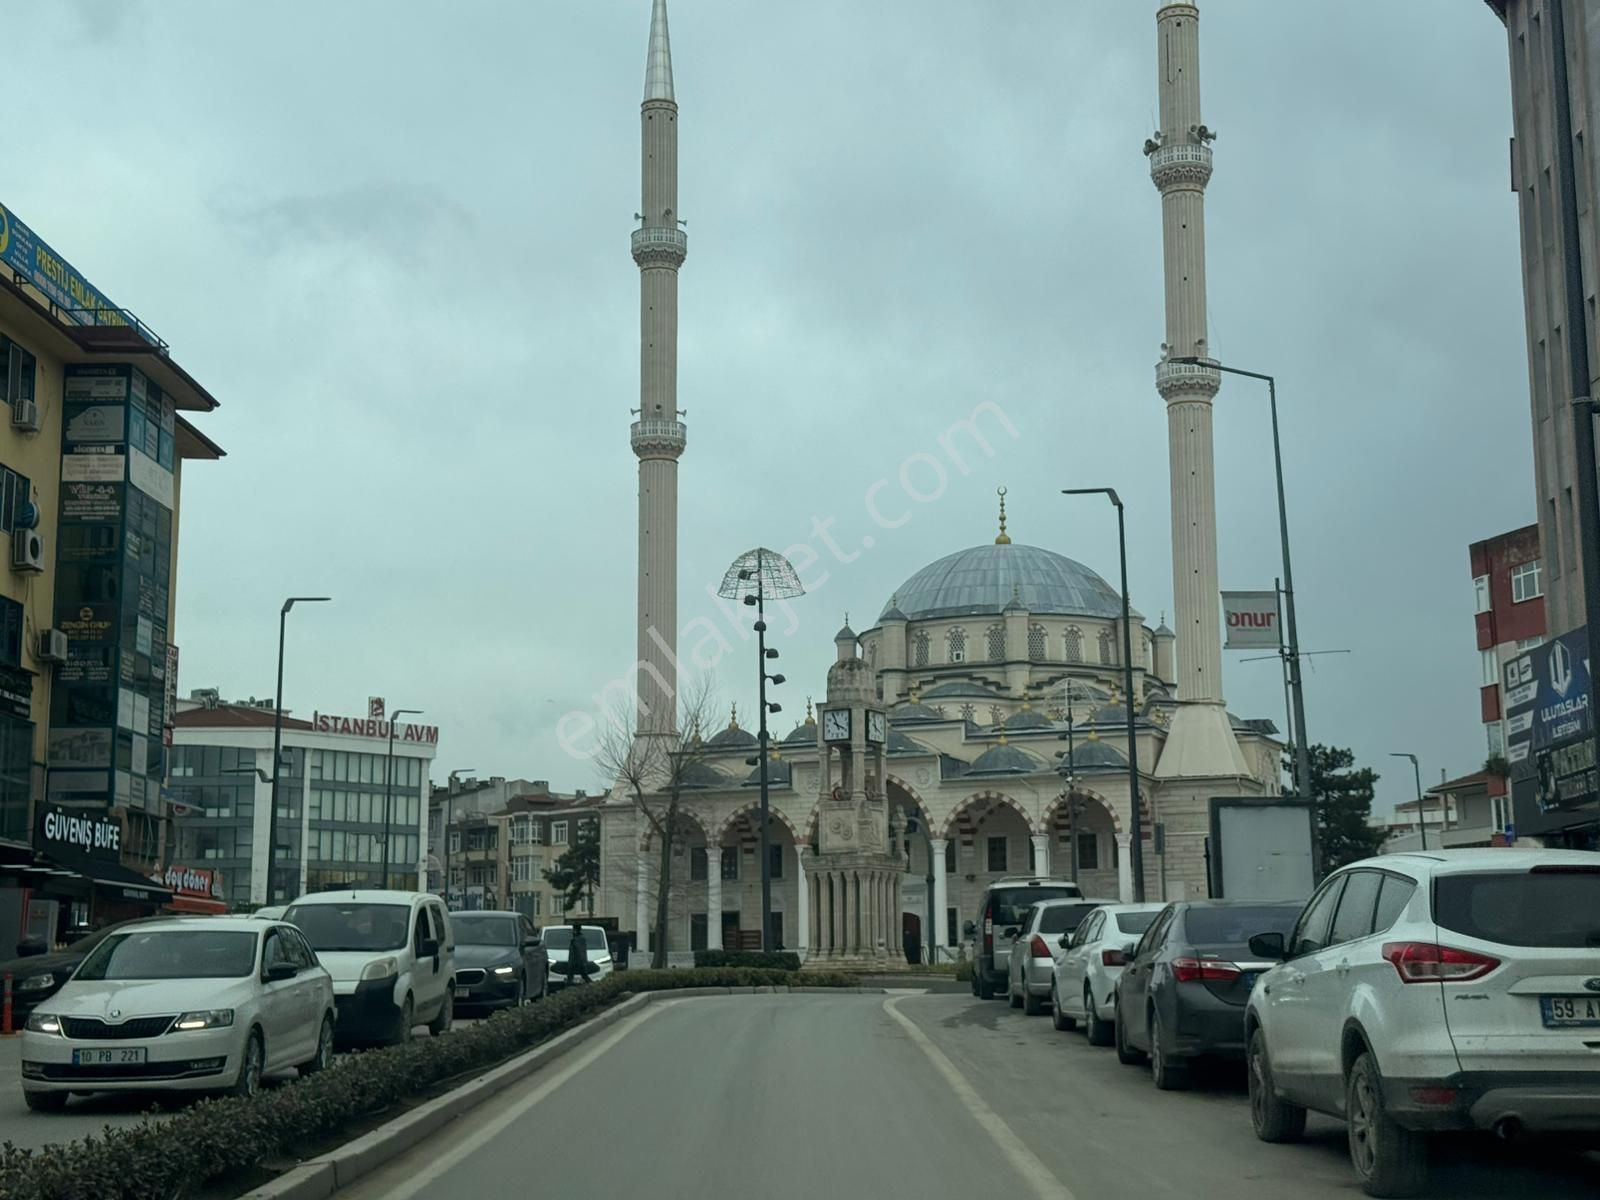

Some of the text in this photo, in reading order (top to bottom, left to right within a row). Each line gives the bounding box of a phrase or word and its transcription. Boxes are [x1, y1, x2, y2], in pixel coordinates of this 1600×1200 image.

[36, 245, 69, 290] PRESTİJ
[70, 275, 96, 309] EMLAK
[1226, 609, 1276, 627] onur
[404, 723, 439, 744] AVM
[45, 807, 120, 852] GÜVENİŞ BÜFE
[1553, 1000, 1600, 1019] 59 A
[81, 1050, 139, 1062] 10 PB 221
